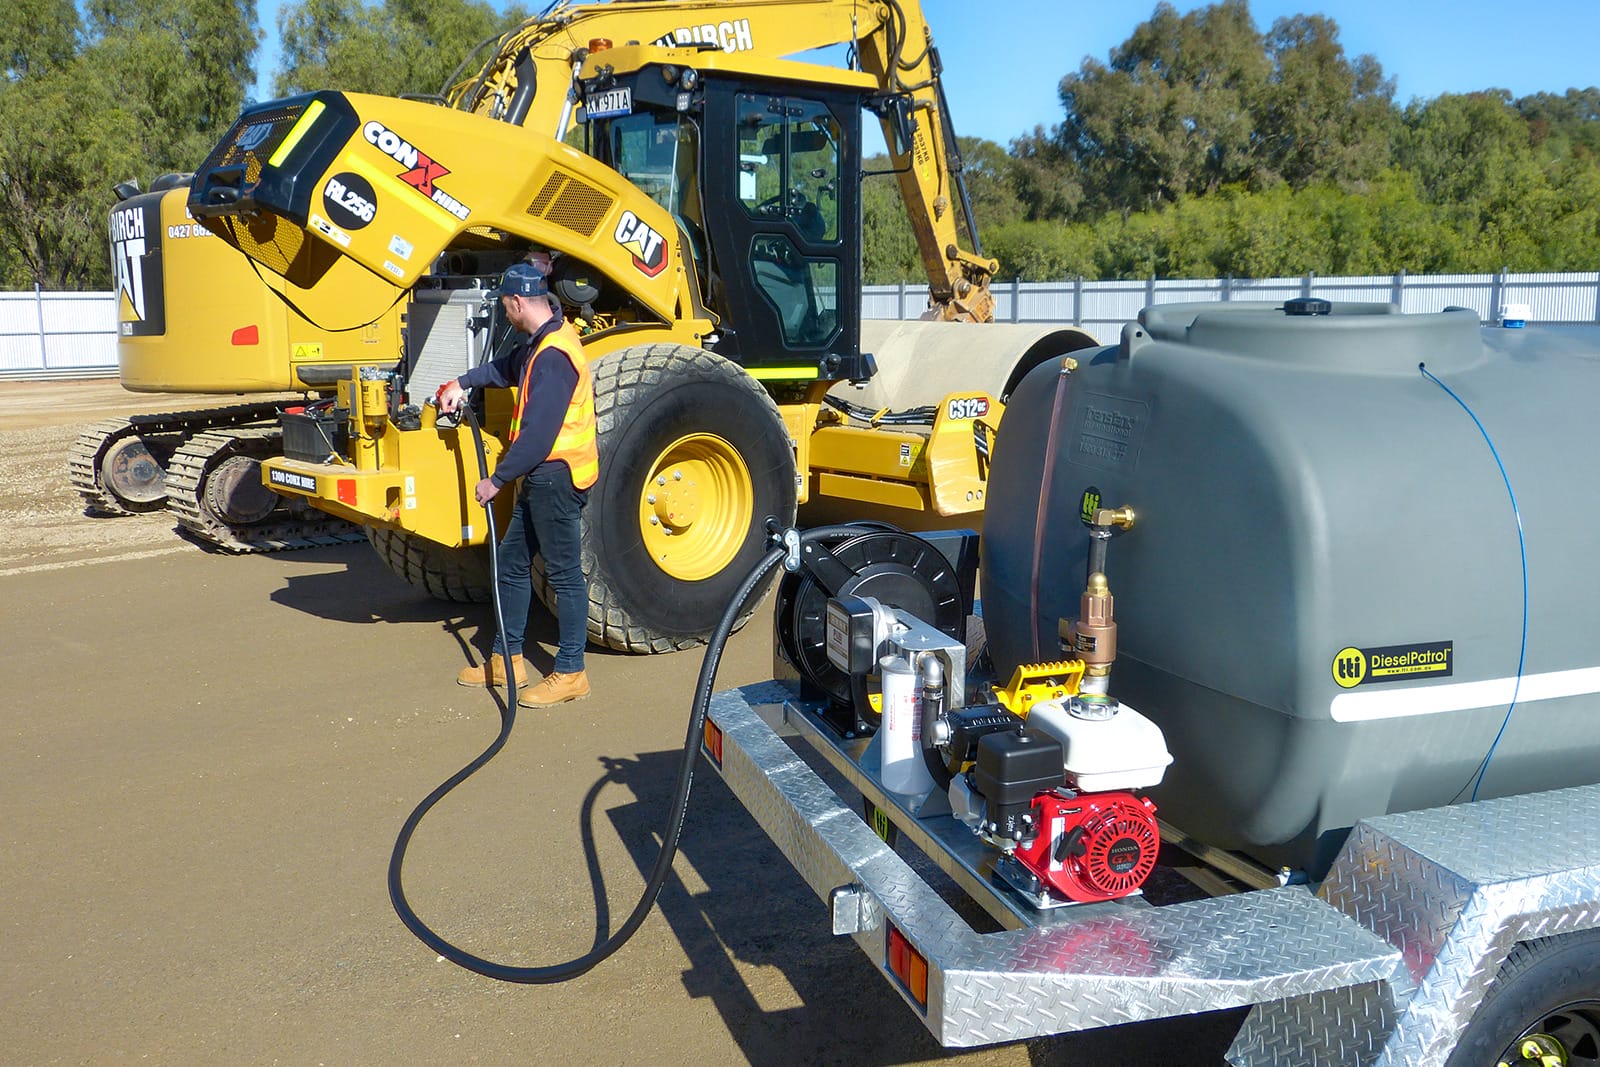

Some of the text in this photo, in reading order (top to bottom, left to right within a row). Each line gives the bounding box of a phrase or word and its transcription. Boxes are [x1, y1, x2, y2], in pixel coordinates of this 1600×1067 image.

[325, 179, 376, 222] RL256
[431, 190, 471, 221] HIRE
[111, 207, 145, 242] BIRCH
[168, 225, 190, 238] 0427
[615, 211, 664, 264] CAT
[949, 399, 977, 419] CS12
[1338, 656, 1361, 679] tti
[1111, 852, 1136, 865] GX
